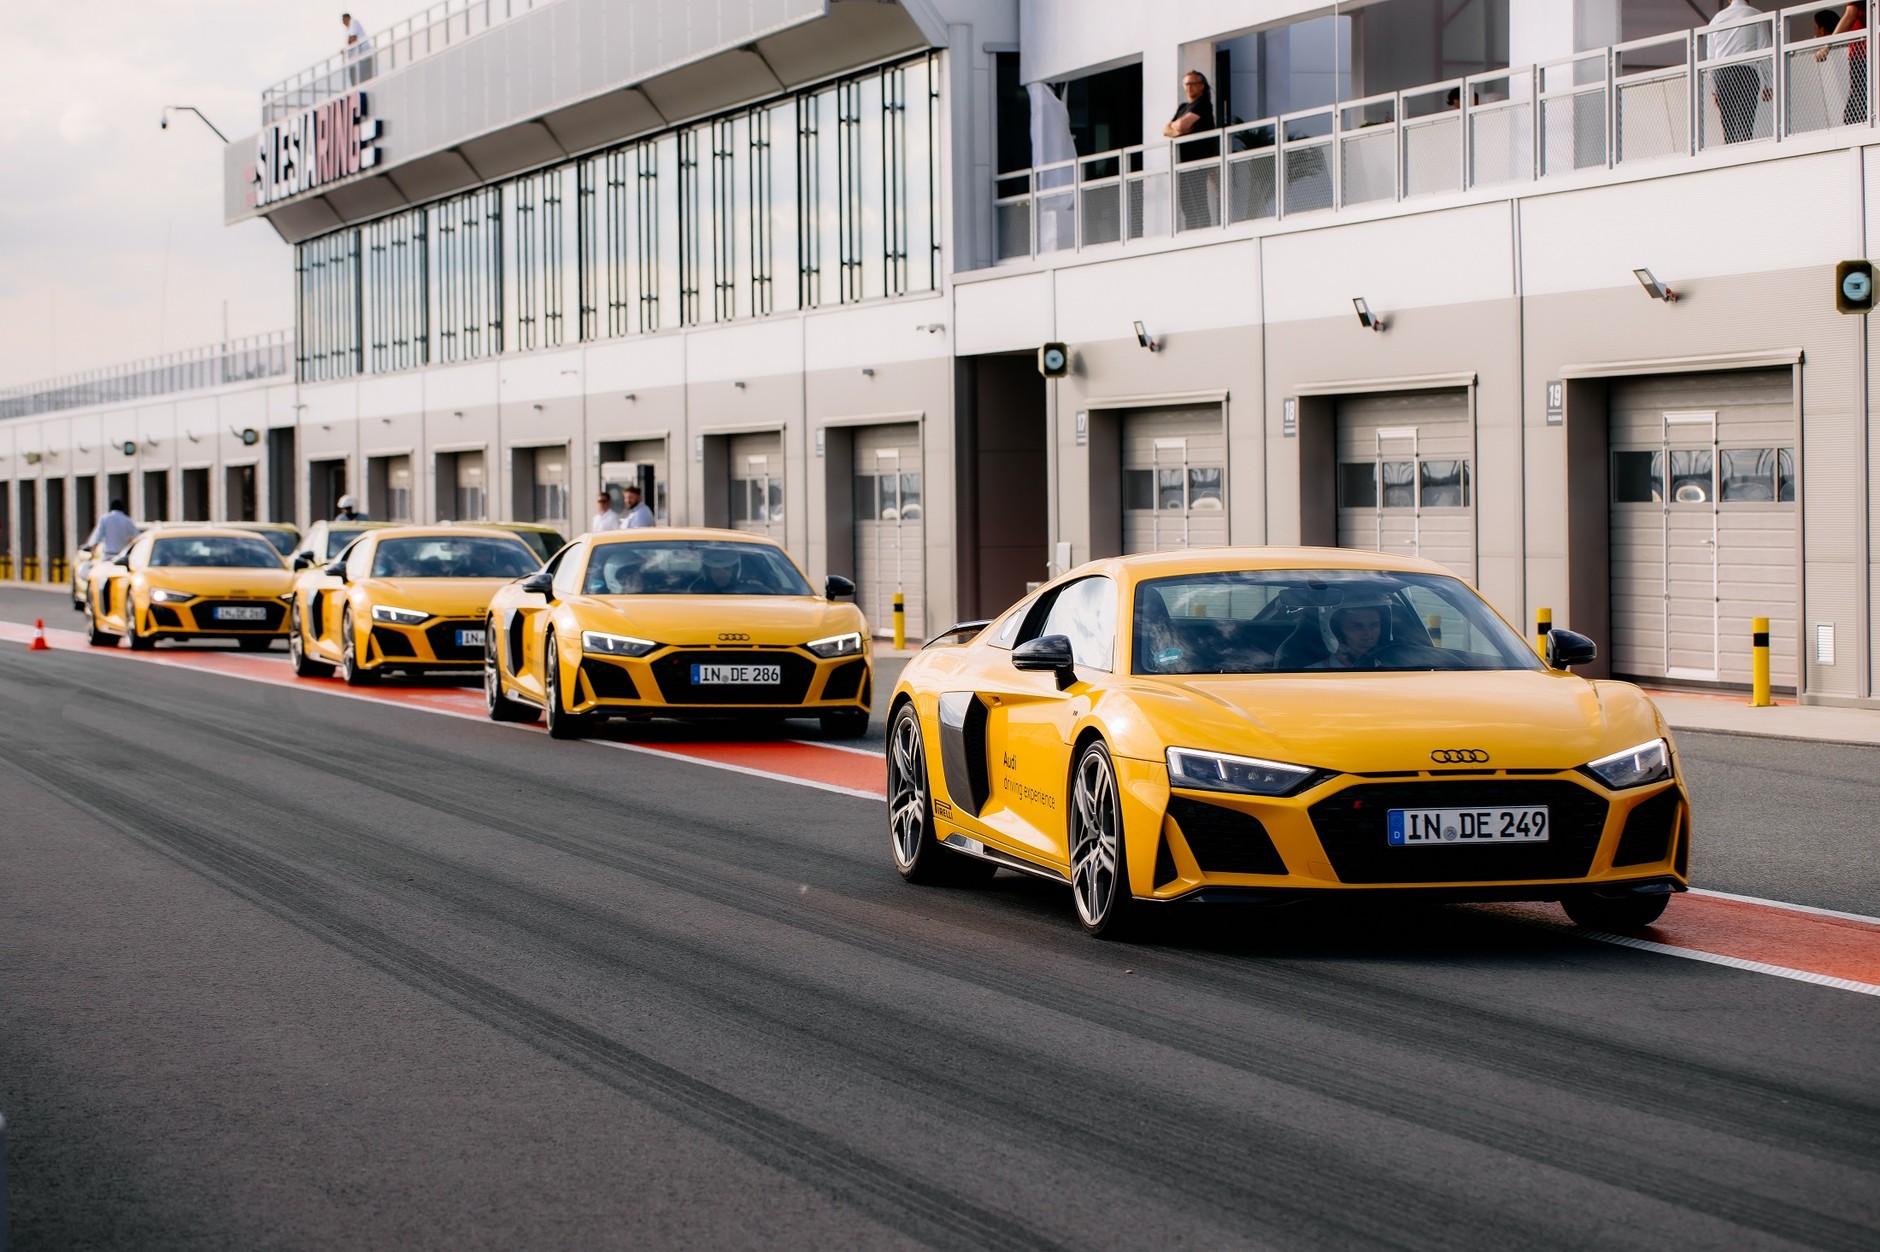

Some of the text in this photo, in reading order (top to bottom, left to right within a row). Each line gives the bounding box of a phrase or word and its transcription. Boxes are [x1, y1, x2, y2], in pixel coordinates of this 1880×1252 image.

[1549, 384, 1561, 407] 19
[1285, 400, 1295, 421] 18
[1077, 413, 1086, 431] 17
[464, 632, 479, 643] IN
[702, 667, 779, 681] IN DE 286
[1003, 750, 1017, 770] Audi
[1003, 774, 1056, 810] driving experience
[934, 798, 953, 820] PIRELLI
[1408, 811, 1546, 840] IN DE 249
